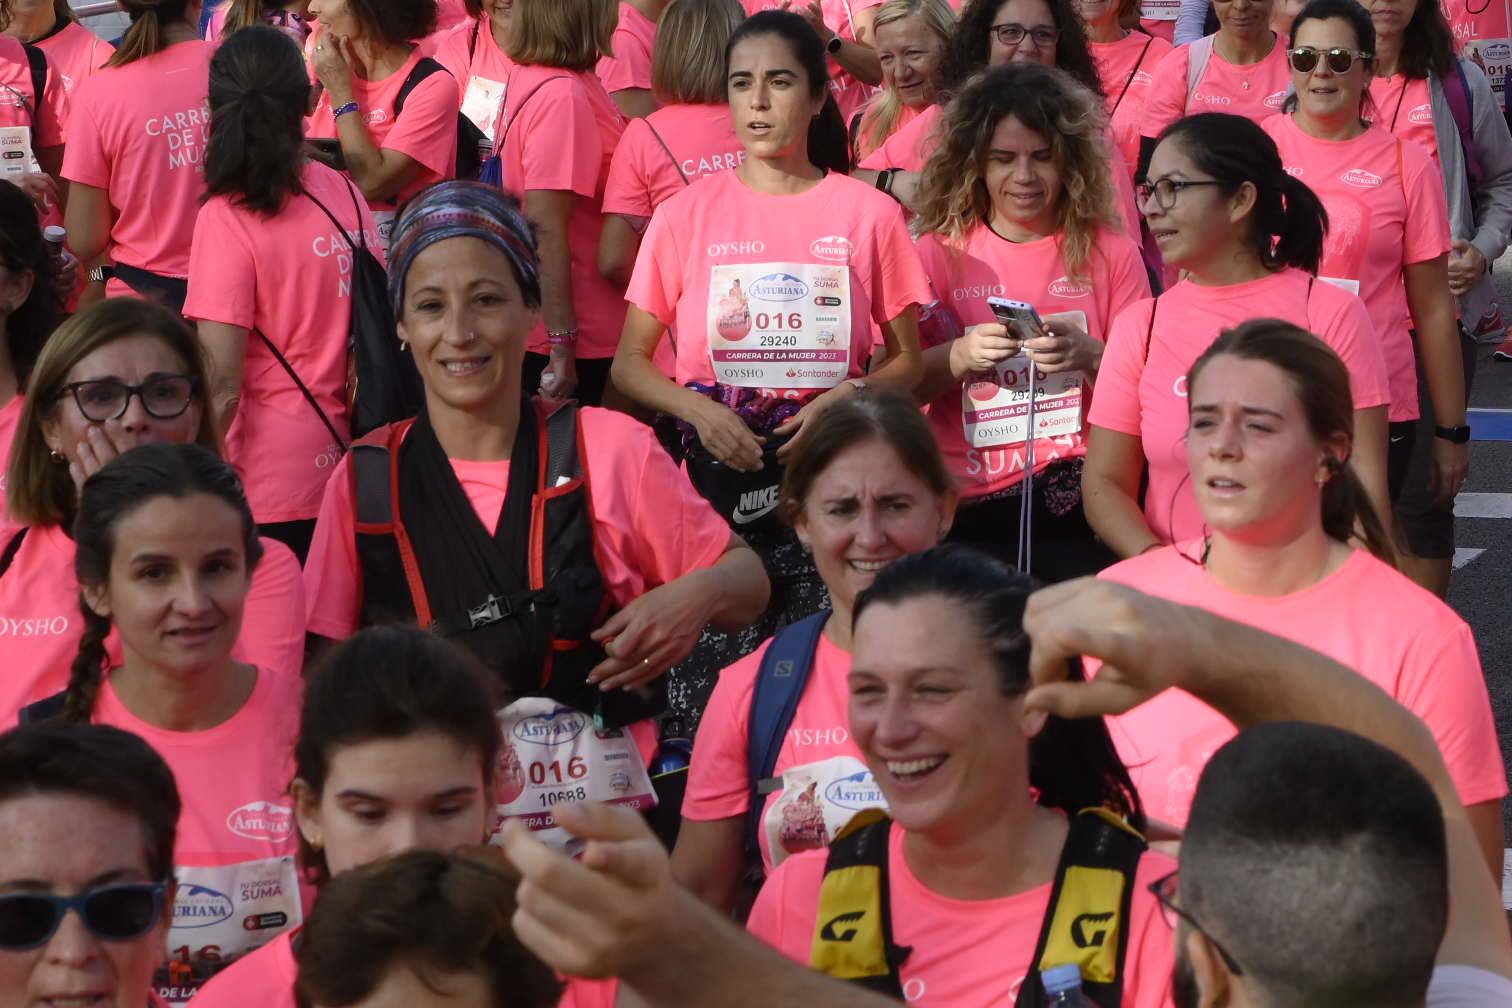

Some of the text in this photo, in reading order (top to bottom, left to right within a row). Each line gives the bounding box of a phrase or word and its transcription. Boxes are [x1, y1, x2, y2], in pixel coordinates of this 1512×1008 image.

[168, 129, 194, 151] DE
[707, 240, 765, 257] OYSHO
[752, 285, 805, 295] ASTURIANA
[814, 280, 840, 289] SUMA
[953, 284, 1006, 301] OYSHO
[755, 312, 803, 330] 016
[759, 335, 797, 347] 29240
[725, 352, 762, 360] CARRERA
[763, 352, 776, 360] DE
[724, 368, 840, 379] OYSHO Santander
[978, 407, 1015, 420] CARRERA
[1039, 400, 1064, 412] MUJER
[978, 423, 1018, 439] OYSHO
[739, 484, 780, 511] NIKE
[529, 755, 588, 785] 016
[240, 885, 283, 902] SUMA
[159, 988, 180, 999] DE
